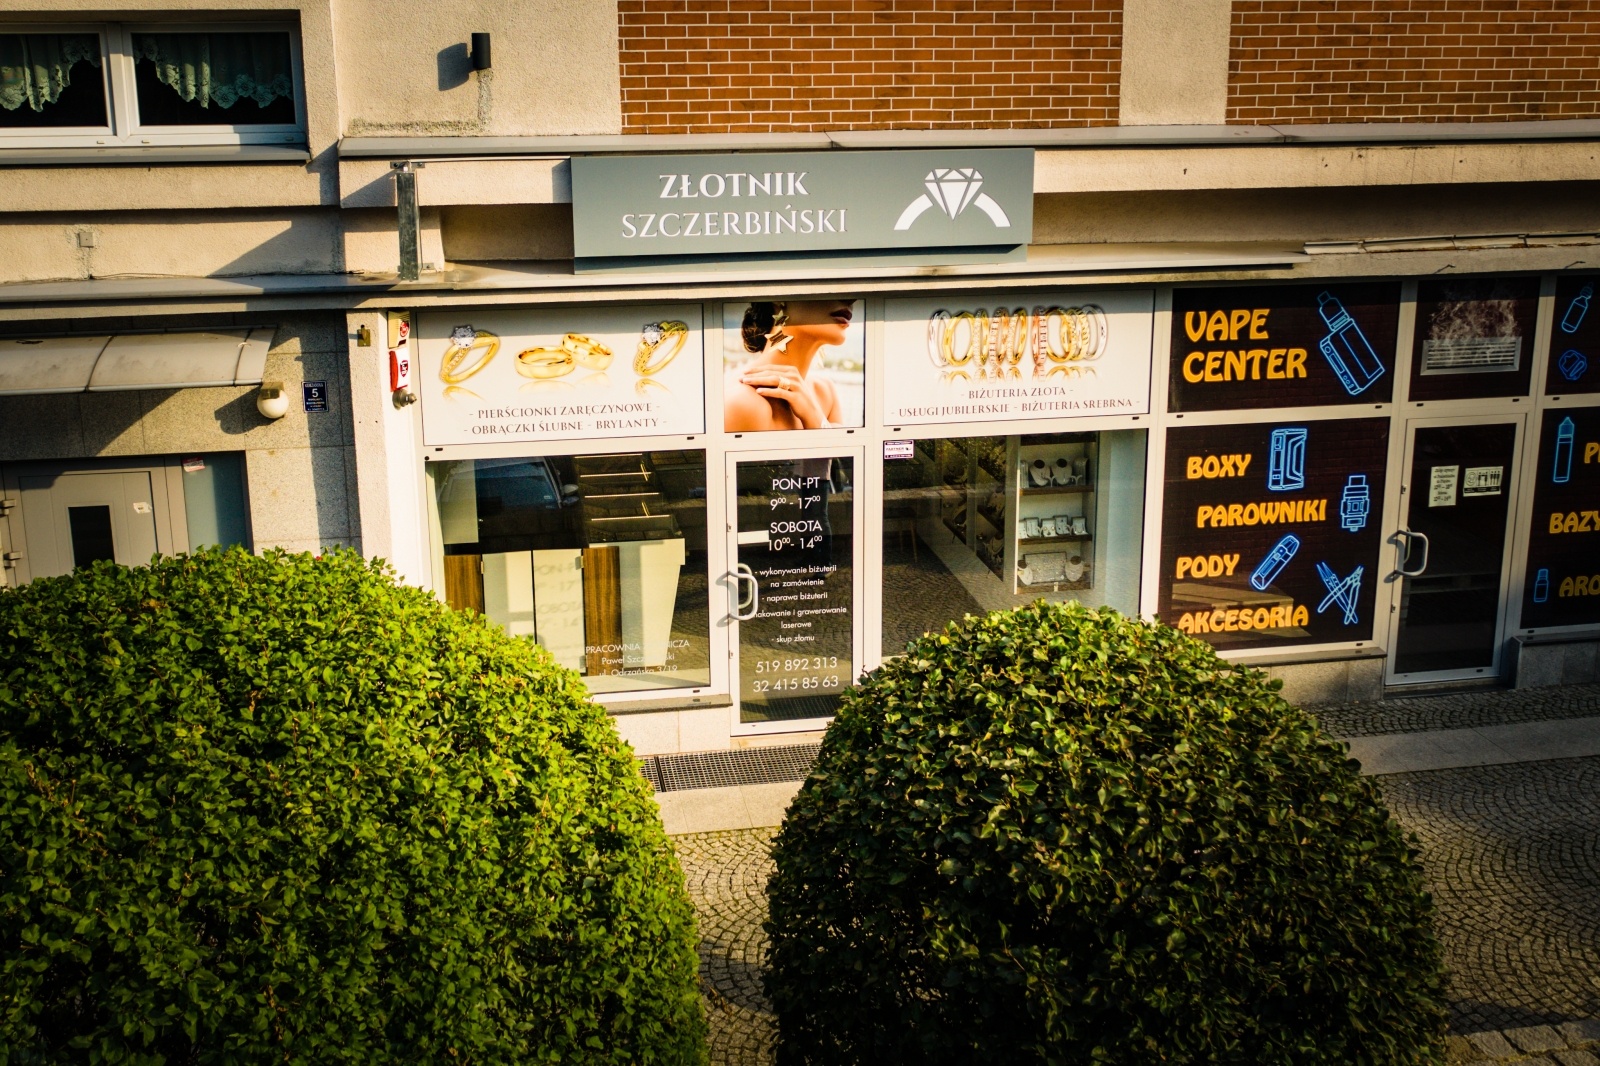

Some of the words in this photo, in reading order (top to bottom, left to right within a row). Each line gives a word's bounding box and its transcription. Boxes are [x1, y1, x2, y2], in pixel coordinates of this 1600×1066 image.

[658, 170, 811, 199] ZŁOTNIK
[621, 204, 848, 239] SZCZERBIŃSKI
[1184, 308, 1270, 343] VAPE
[1182, 347, 1308, 383] CENTER
[312, 388, 318, 398] 5
[968, 387, 1028, 400] BIŻUTERIA
[1030, 386, 1066, 397] ZŁOTA
[477, 405, 557, 419] PIERŚCIONKI
[559, 402, 653, 417] ZARĘCZYNOWE
[899, 406, 939, 417] USŁUGI
[941, 403, 1010, 416] JUBILERSKIE
[1021, 399, 1080, 412] BIŻUTERIA
[1082, 397, 1133, 409] SREBRNA
[471, 422, 536, 436] OBRĄCZKI
[538, 420, 584, 432] ŚLUBNE
[595, 417, 659, 430] BRYLANTY
[1583, 442, 1600, 464] P
[1186, 453, 1252, 480] BOXY
[772, 476, 821, 491] PON-PT
[1196, 499, 1328, 529] PAROWNIKI
[1548, 510, 1600, 534] BAZY
[770, 520, 823, 534] SOBOTA
[759, 566, 807, 578] wykonywanie
[808, 564, 837, 573] biżuterii
[1175, 553, 1241, 580] PODY
[782, 578, 825, 588] zamówienie
[766, 594, 798, 604] naprawa
[800, 592, 828, 600] biżuterii
[796, 606, 848, 618] grawerowanie
[1177, 604, 1310, 635] AKCESORIA
[780, 620, 812, 629] laserowe
[776, 634, 792, 644] skup
[794, 634, 815, 642] złomu
[586, 643, 640, 654] PRACOWNIA
[755, 660, 780, 674] 519
[784, 658, 810, 672] 892
[812, 656, 838, 670] 313
[752, 680, 770, 693] 32
[773, 678, 798, 691] 415
[802, 676, 818, 689] 85
[822, 675, 839, 688] 63
